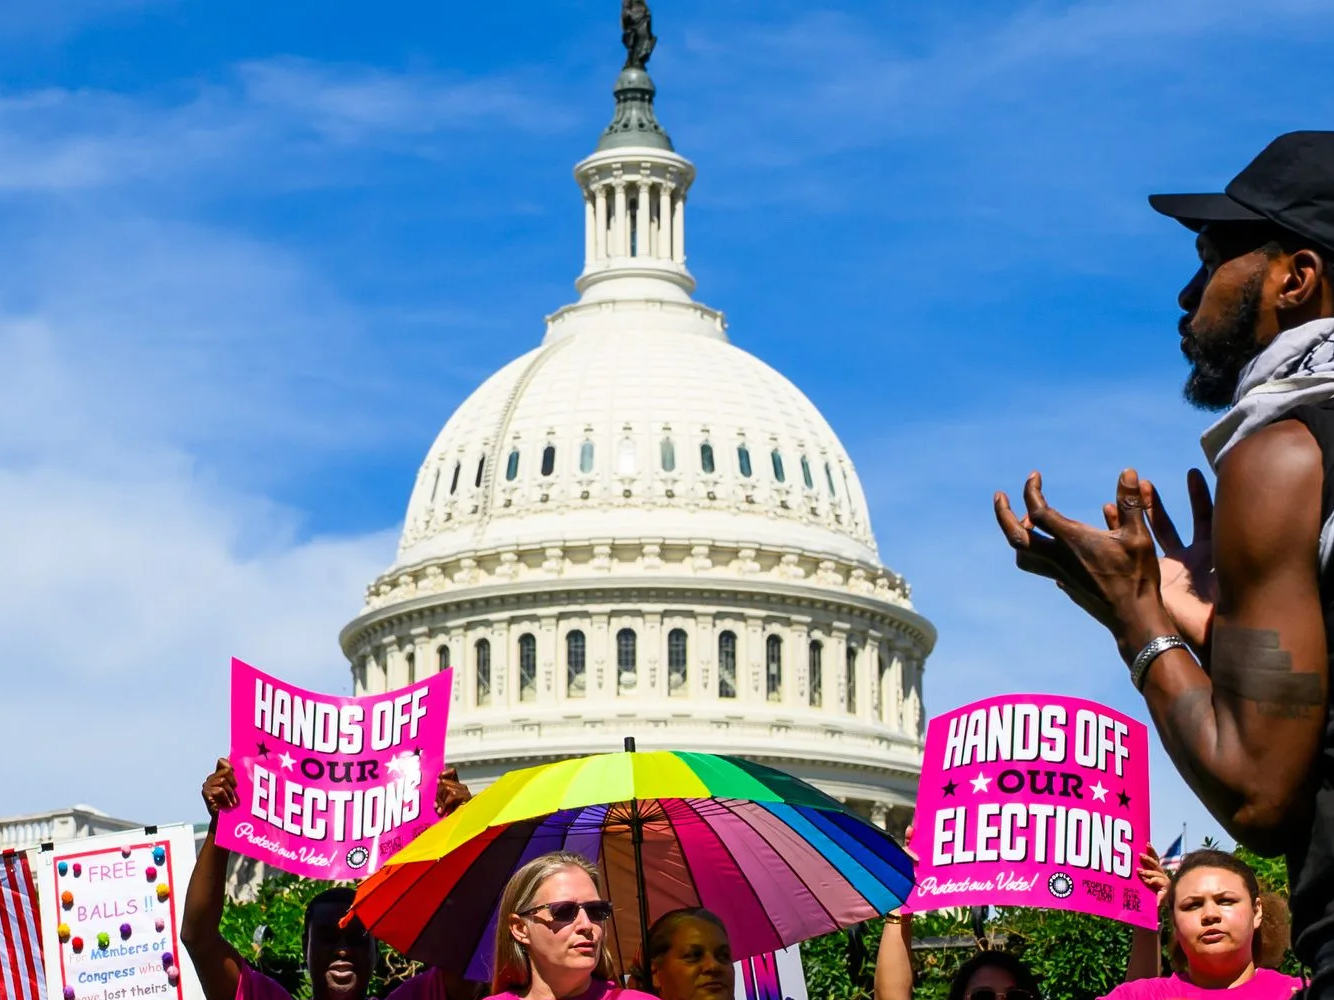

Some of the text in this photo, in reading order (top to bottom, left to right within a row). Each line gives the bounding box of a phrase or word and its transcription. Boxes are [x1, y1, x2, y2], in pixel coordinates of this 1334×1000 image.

[255, 678, 429, 754] HANDS OFF
[943, 703, 1128, 776] HANDS OFF
[300, 757, 379, 783] OUR
[997, 769, 1083, 798] OUR
[251, 762, 421, 843] ELECTIONS
[234, 822, 338, 867] Protect our Vote!
[933, 803, 1133, 879] ELECTIONS
[88, 860, 136, 883] FREE
[918, 872, 1039, 896] Protect our Vote!
[77, 899, 138, 922] BALLS
[91, 937, 166, 960] Members of
[78, 963, 162, 984] Congress who
[104, 983, 167, 1000] lost theirs
